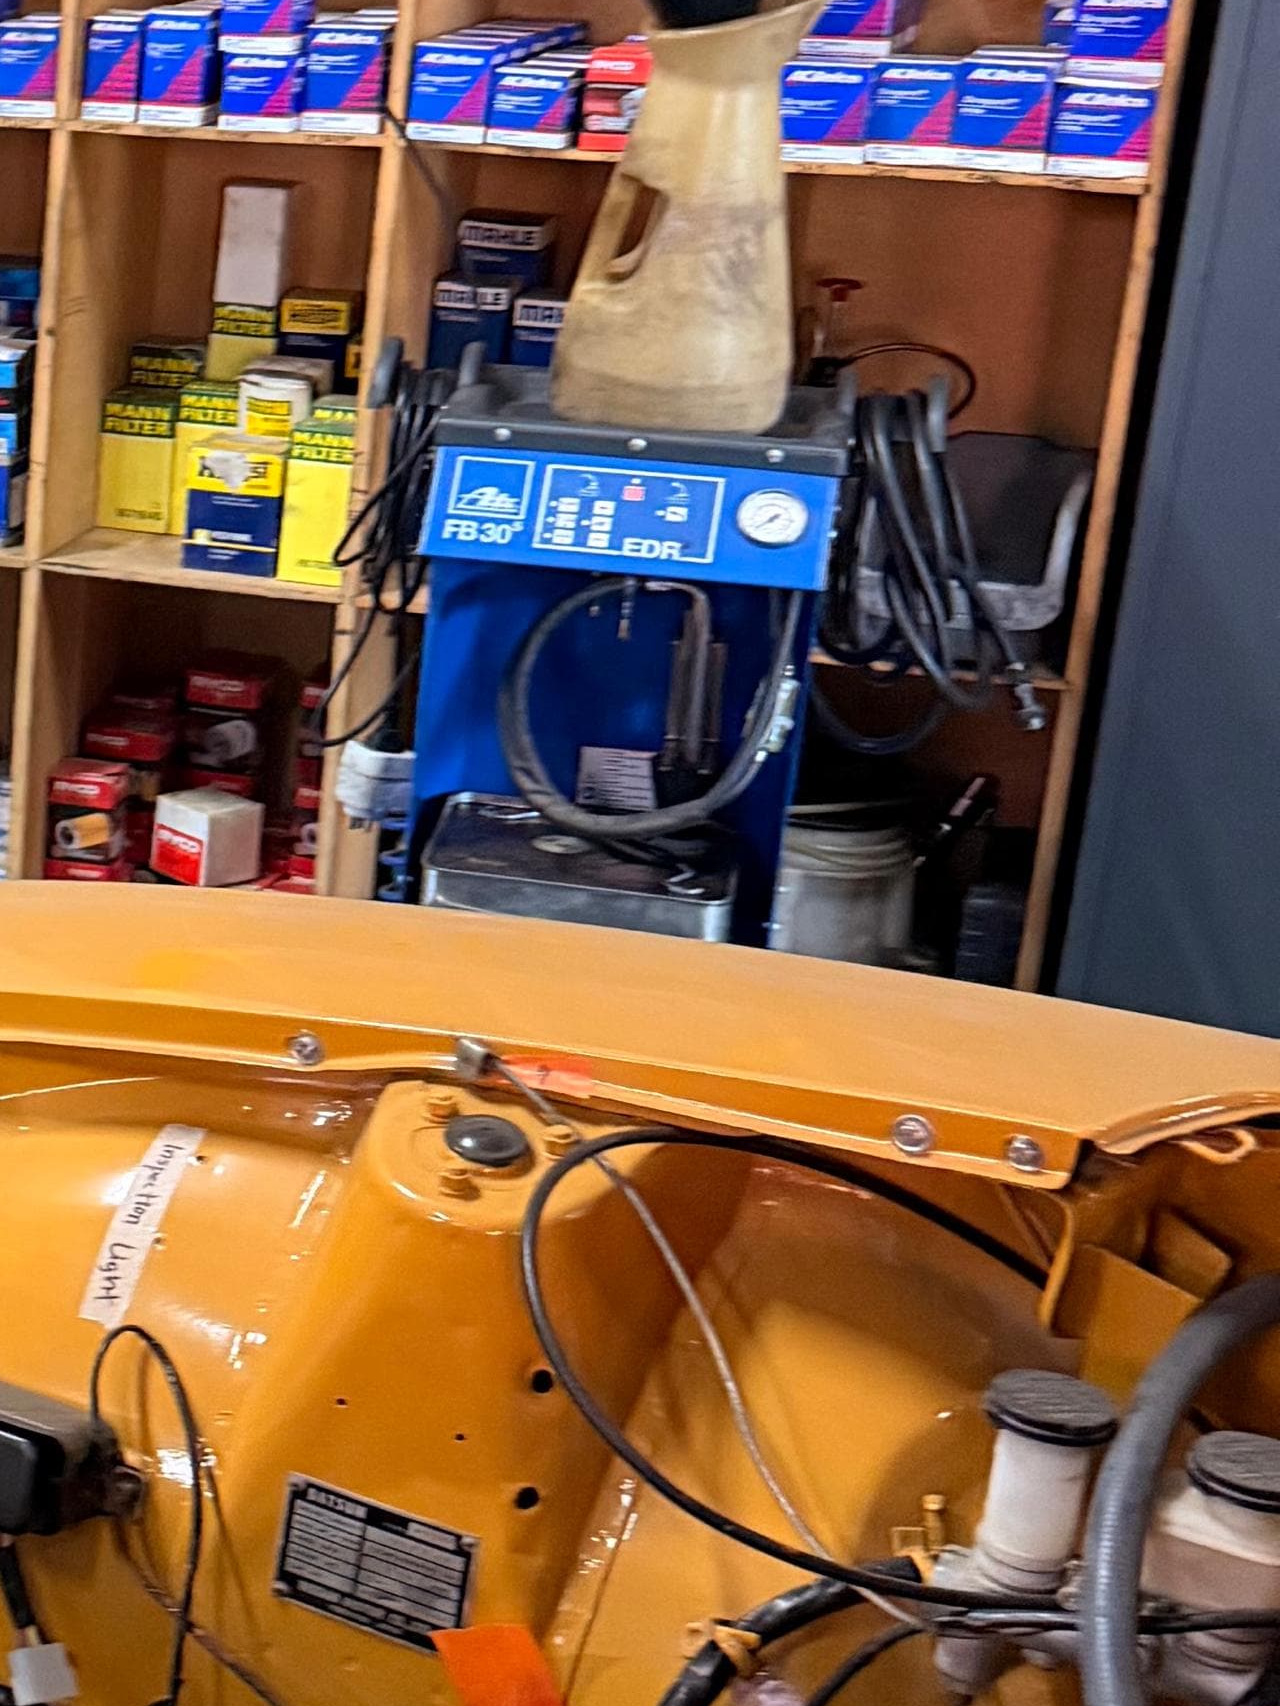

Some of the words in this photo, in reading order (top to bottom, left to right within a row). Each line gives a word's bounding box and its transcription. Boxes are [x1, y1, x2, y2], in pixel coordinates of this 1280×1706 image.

[105, 403, 171, 420] MANN
[104, 417, 171, 435] FILTER
[622, 537, 682, 561] EDR
[122, 1144, 186, 1225] Inspection
[92, 1242, 138, 1305] Light
